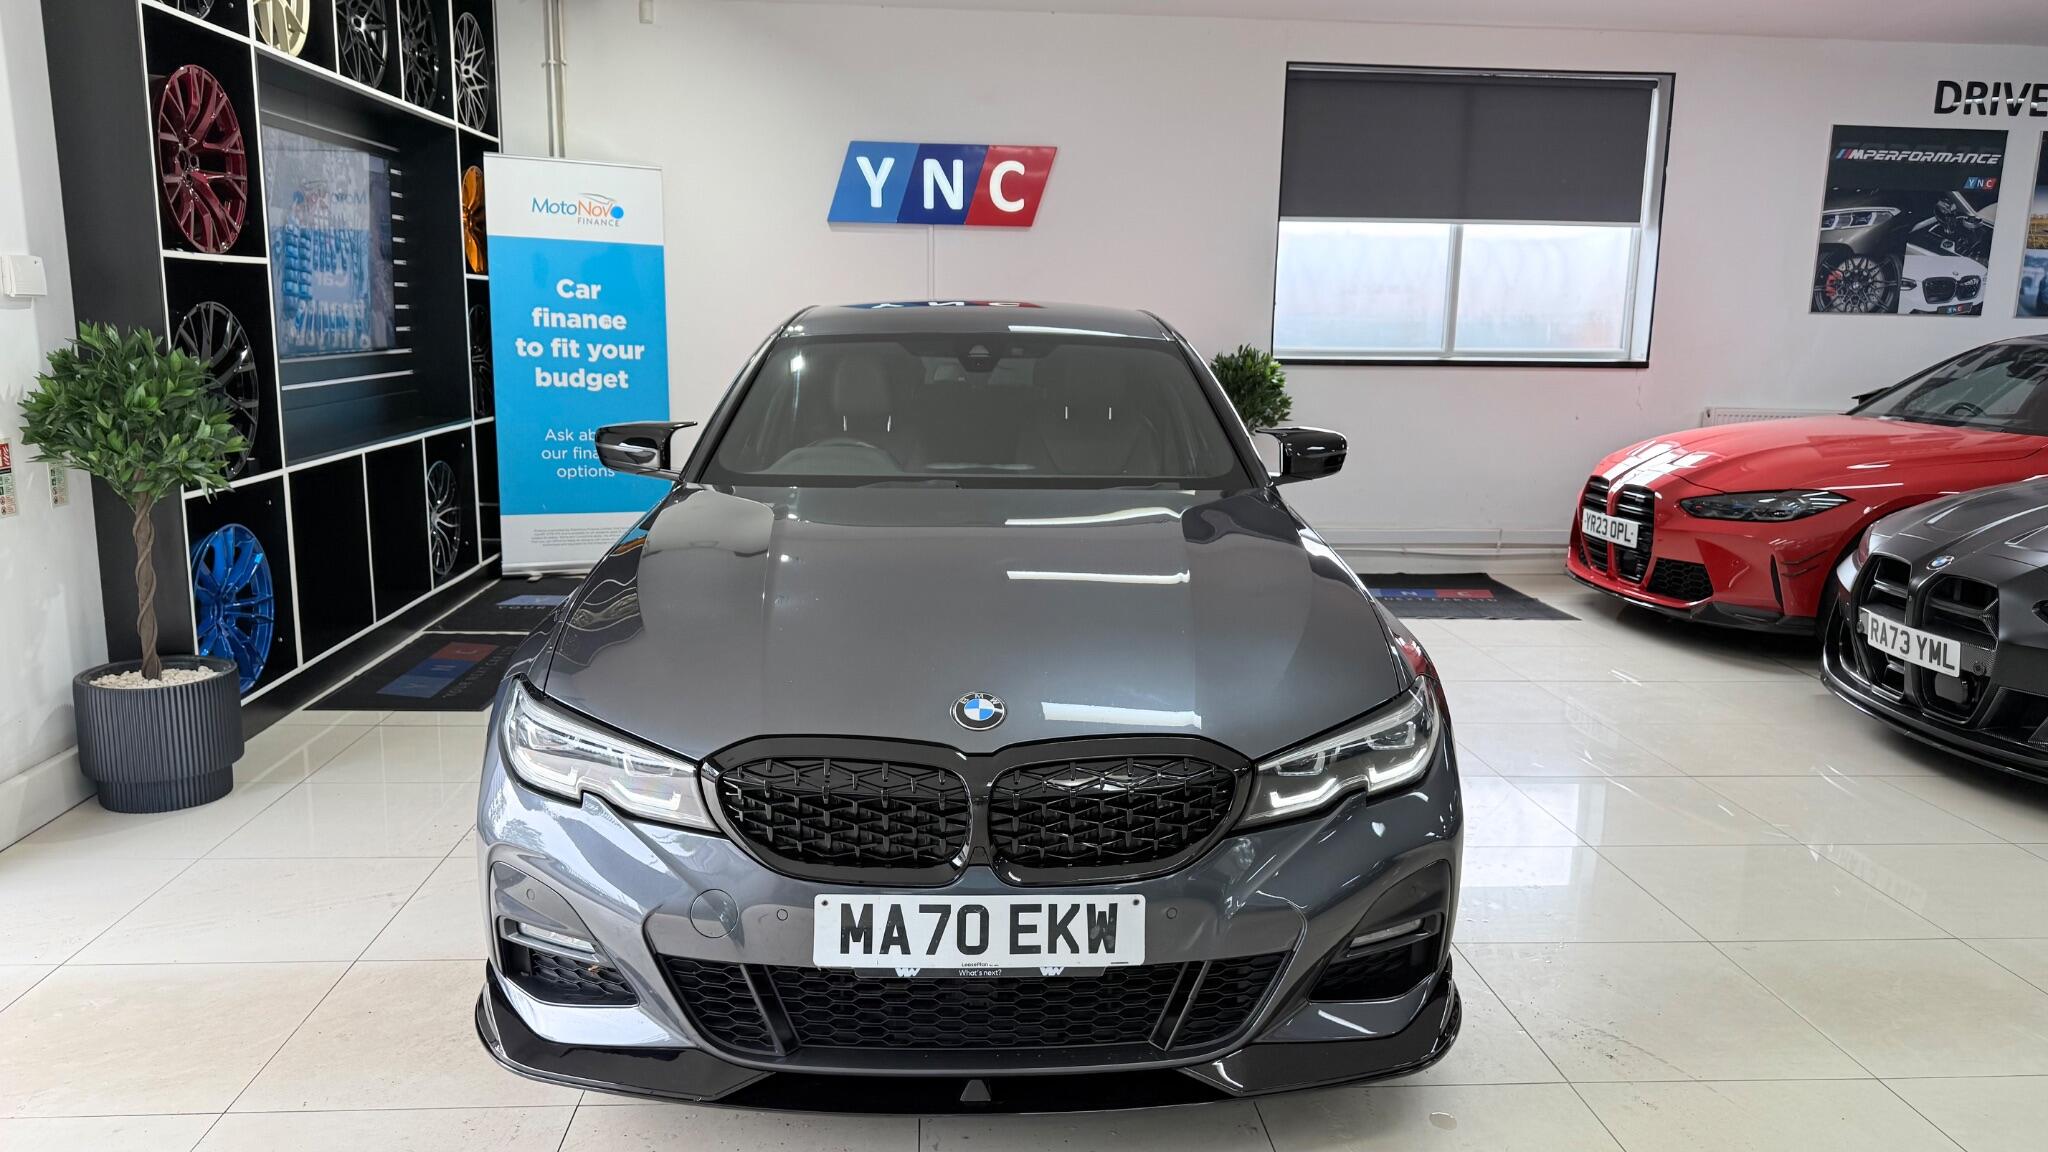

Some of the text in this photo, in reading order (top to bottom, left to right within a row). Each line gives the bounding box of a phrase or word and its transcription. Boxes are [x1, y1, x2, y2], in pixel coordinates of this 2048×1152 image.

[1934, 80, 2048, 117] DRIVE
[1968, 178, 1994, 188] YNC
[577, 217, 619, 227] FINANCE
[556, 278, 602, 299] Car
[531, 307, 627, 330] finance
[515, 338, 645, 362] to fit your
[535, 367, 629, 392] budget
[544, 428, 574, 441] Ask
[541, 447, 600, 460] our fina
[556, 465, 616, 480] options
[1586, 512, 1632, 542] YR23 OPL
[1870, 617, 1956, 671] RA73 YML
[839, 902, 1119, 956] MA70 EKW
[958, 968, 1002, 977] What's next?
